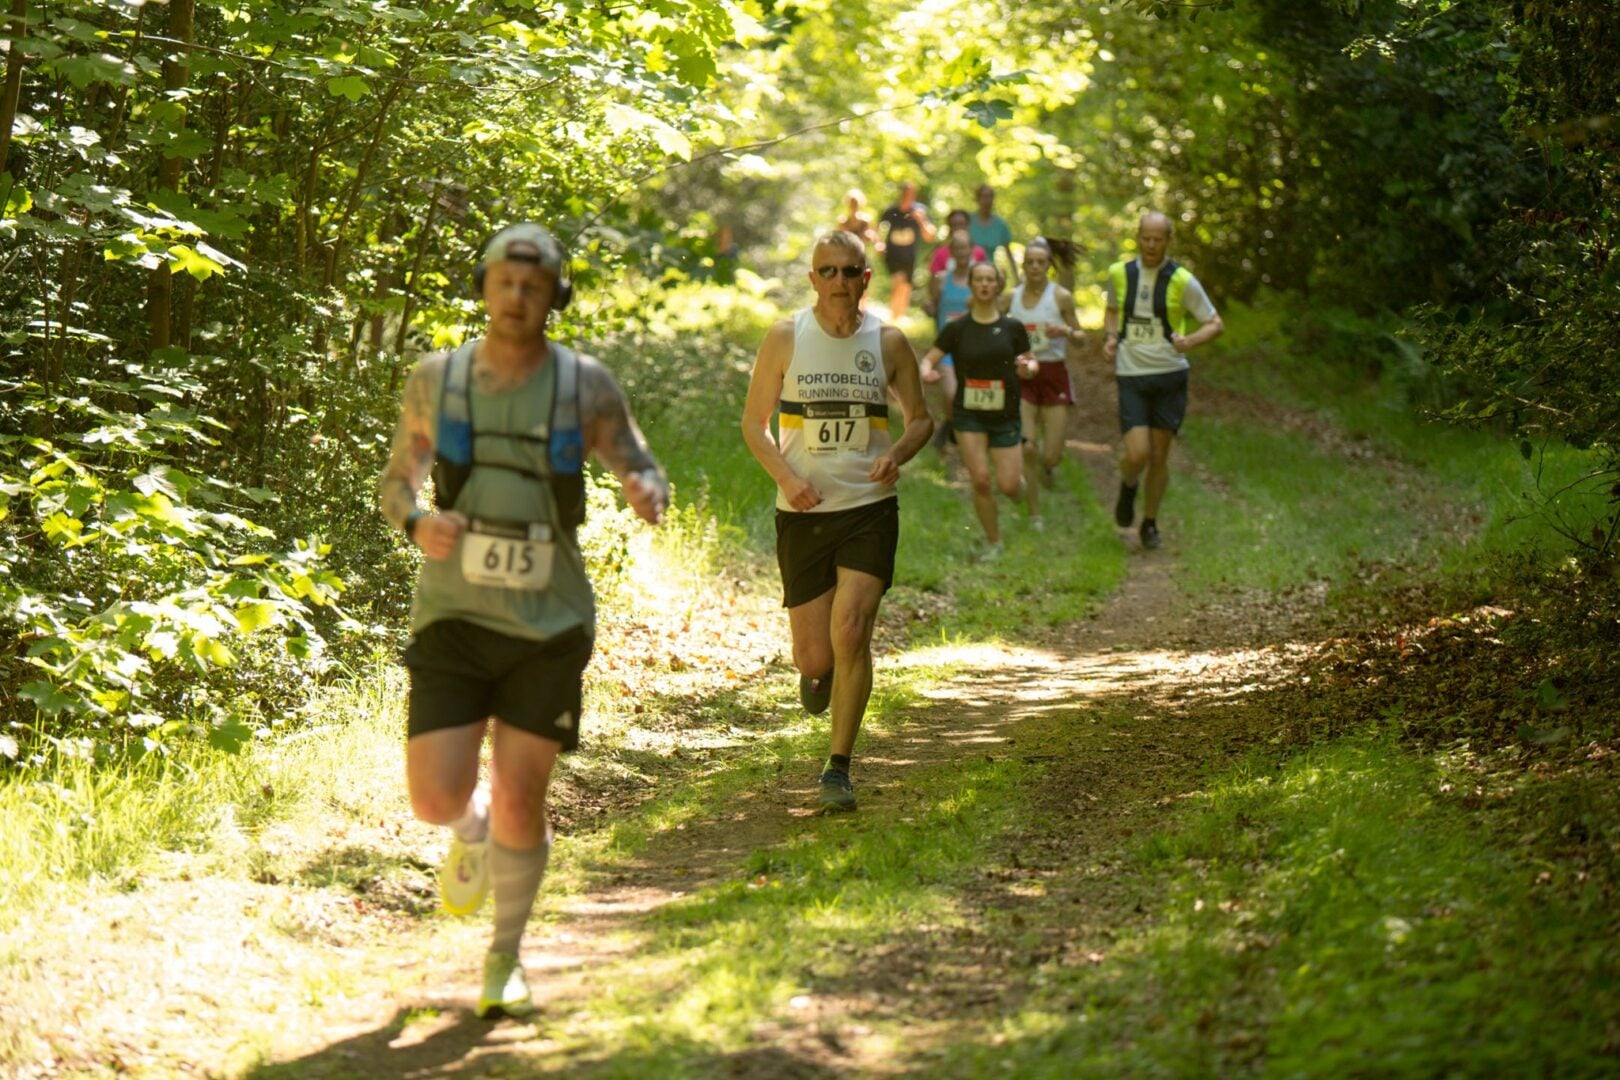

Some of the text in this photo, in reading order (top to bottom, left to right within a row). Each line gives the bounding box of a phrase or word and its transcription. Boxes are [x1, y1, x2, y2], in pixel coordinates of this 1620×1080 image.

[797, 373, 879, 387] PORTOBELLO
[798, 388, 879, 401] RUNNING CLUB
[819, 420, 856, 443] 617
[484, 542, 534, 575] 615
